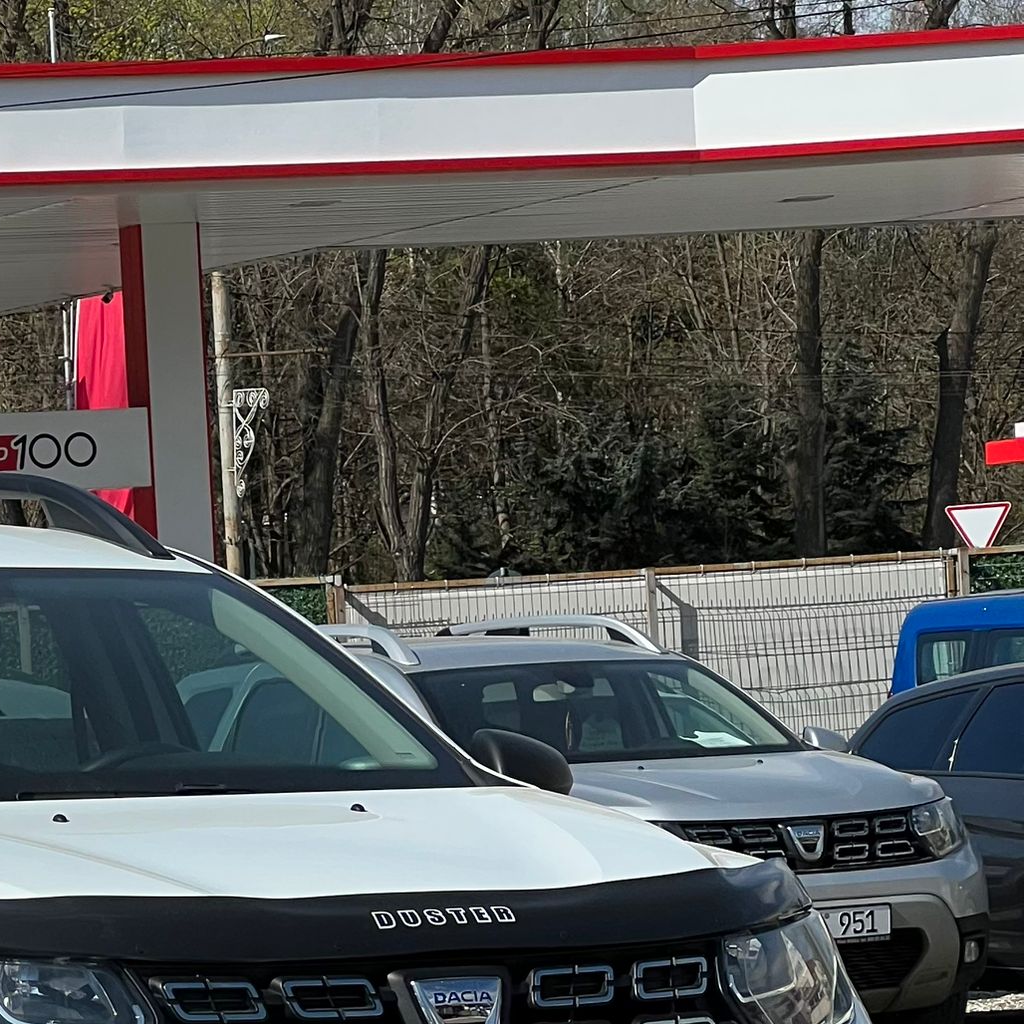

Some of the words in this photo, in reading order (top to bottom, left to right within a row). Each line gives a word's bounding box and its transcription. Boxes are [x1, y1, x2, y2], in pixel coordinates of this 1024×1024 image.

[371, 906, 517, 930] DUSTER
[839, 910, 878, 935] 951
[433, 991, 493, 1005] DACIA
